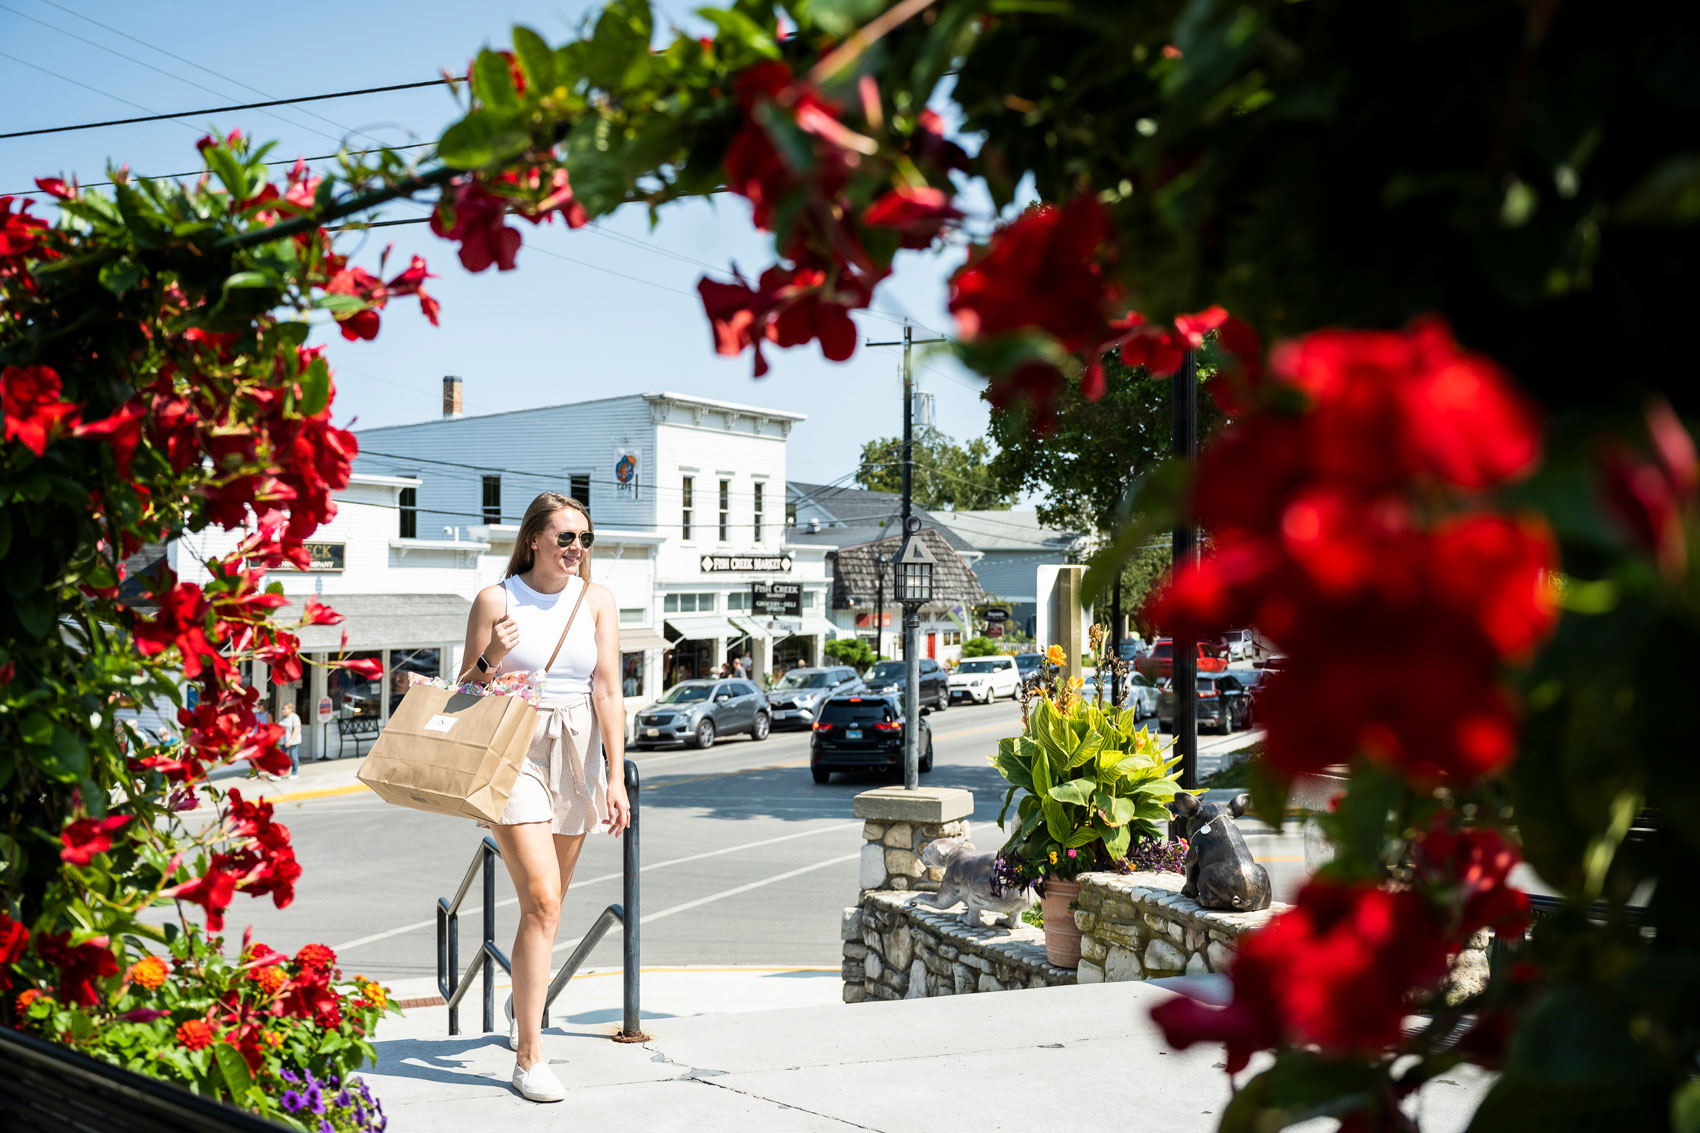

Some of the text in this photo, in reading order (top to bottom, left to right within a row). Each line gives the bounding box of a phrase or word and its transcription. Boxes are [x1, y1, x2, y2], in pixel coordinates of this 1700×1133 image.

[713, 558, 781, 570] FISH CREEK MARKET
[754, 584, 799, 594] FISH CREEK
